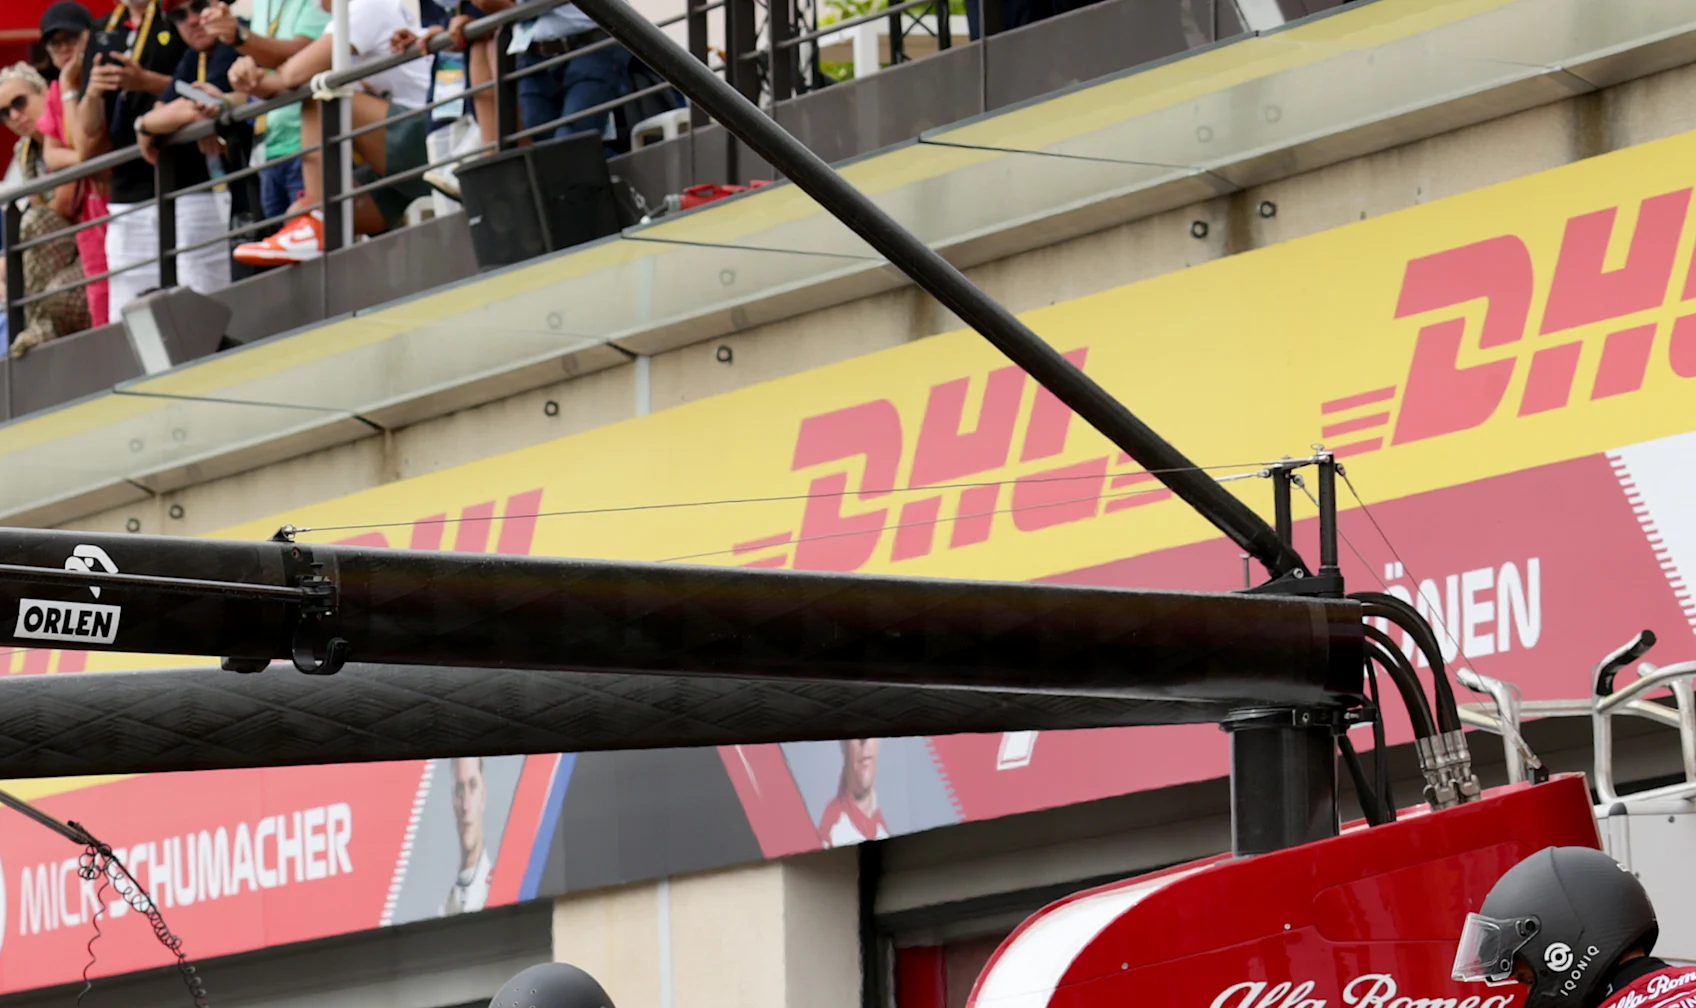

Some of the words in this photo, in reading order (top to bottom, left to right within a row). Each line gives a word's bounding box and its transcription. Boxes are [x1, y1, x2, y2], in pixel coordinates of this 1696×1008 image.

[1391, 187, 1696, 447] DH
[791, 347, 1110, 572] DHL
[22, 605, 114, 638] ORLEN
[107, 802, 353, 918] SCHUMACHER
[1560, 944, 1600, 996] IQONIQ
